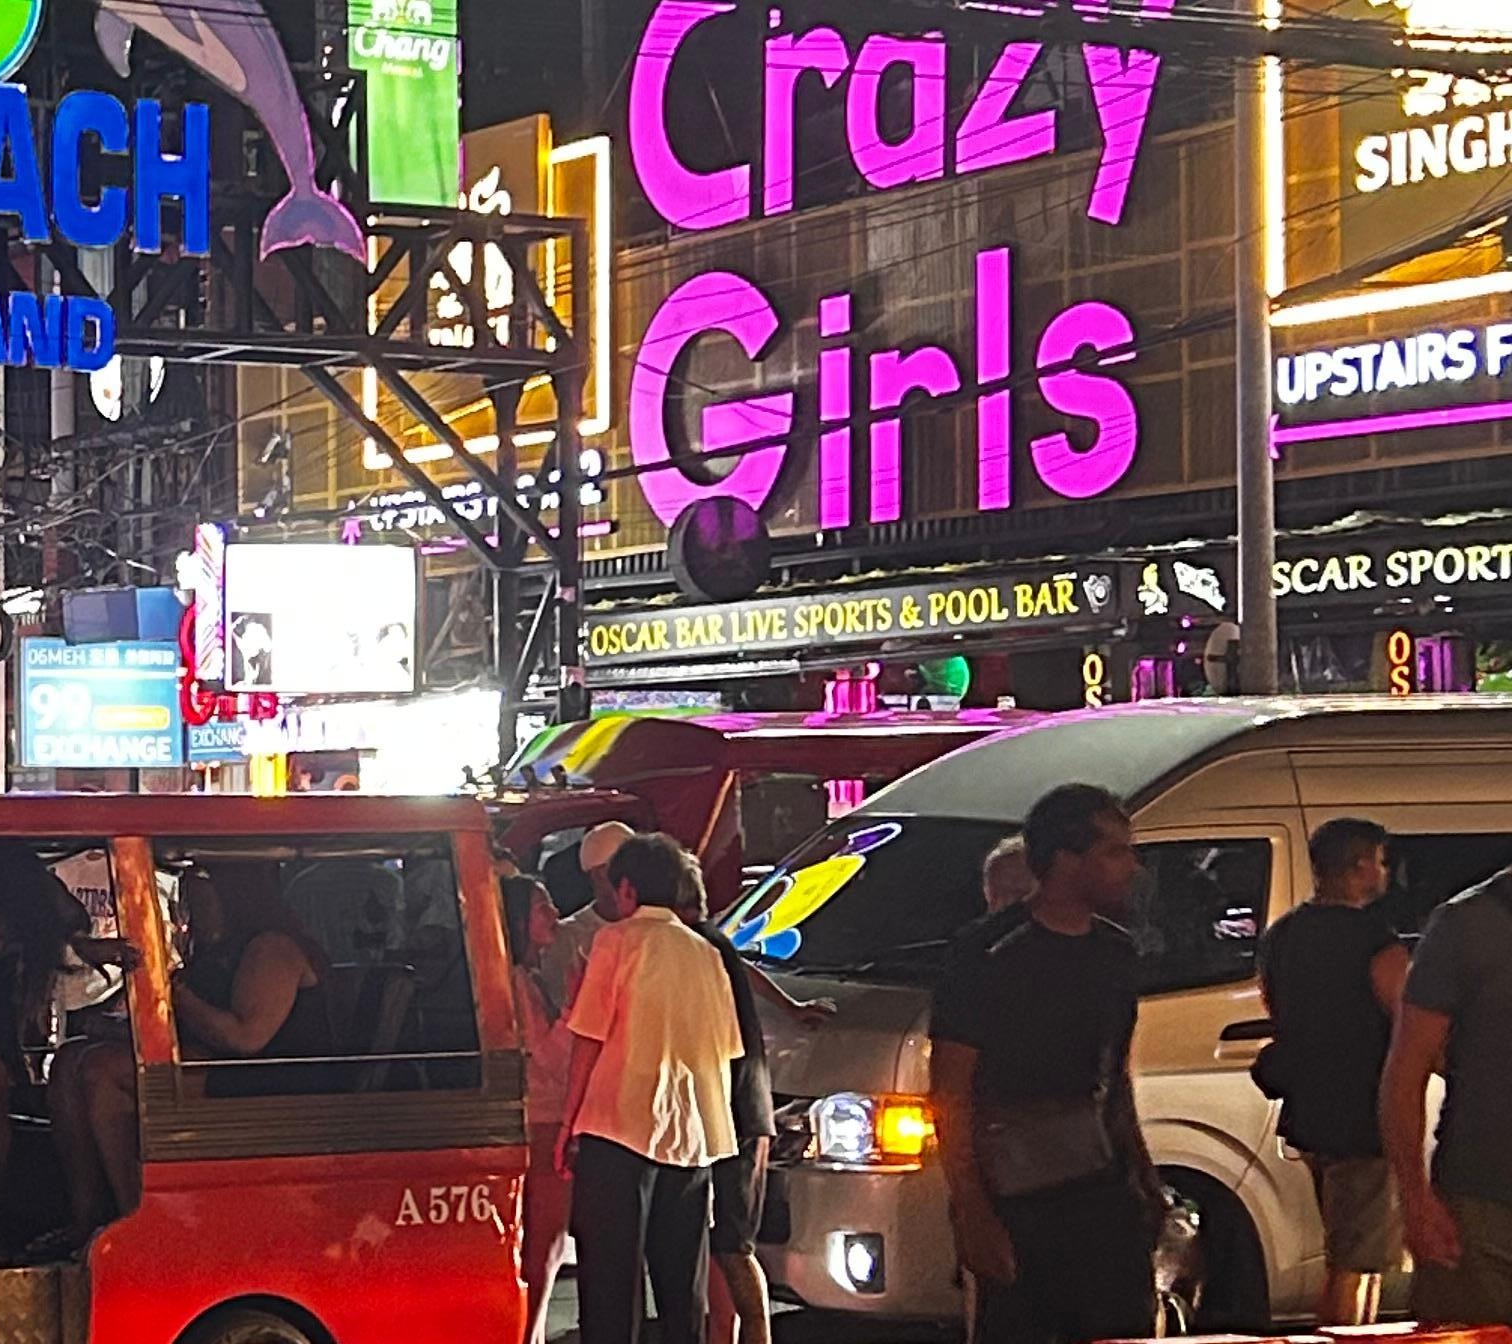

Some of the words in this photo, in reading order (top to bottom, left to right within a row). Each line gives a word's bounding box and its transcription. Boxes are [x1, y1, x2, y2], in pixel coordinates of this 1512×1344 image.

[354, 23, 451, 71] Chang
[629, 247, 1139, 531] Girls
[1276, 329, 1477, 405] UPSTAIRS
[1272, 555, 1378, 597] SCAR
[591, 617, 670, 657] OSCAR
[675, 613, 726, 649] BAR
[731, 606, 788, 644] LIVE
[793, 597, 894, 639] SPORTS
[899, 596, 924, 630] &
[929, 586, 1009, 627] POOL
[1013, 576, 1080, 618] BAR
[33, 734, 173, 762] EXCHANGE
